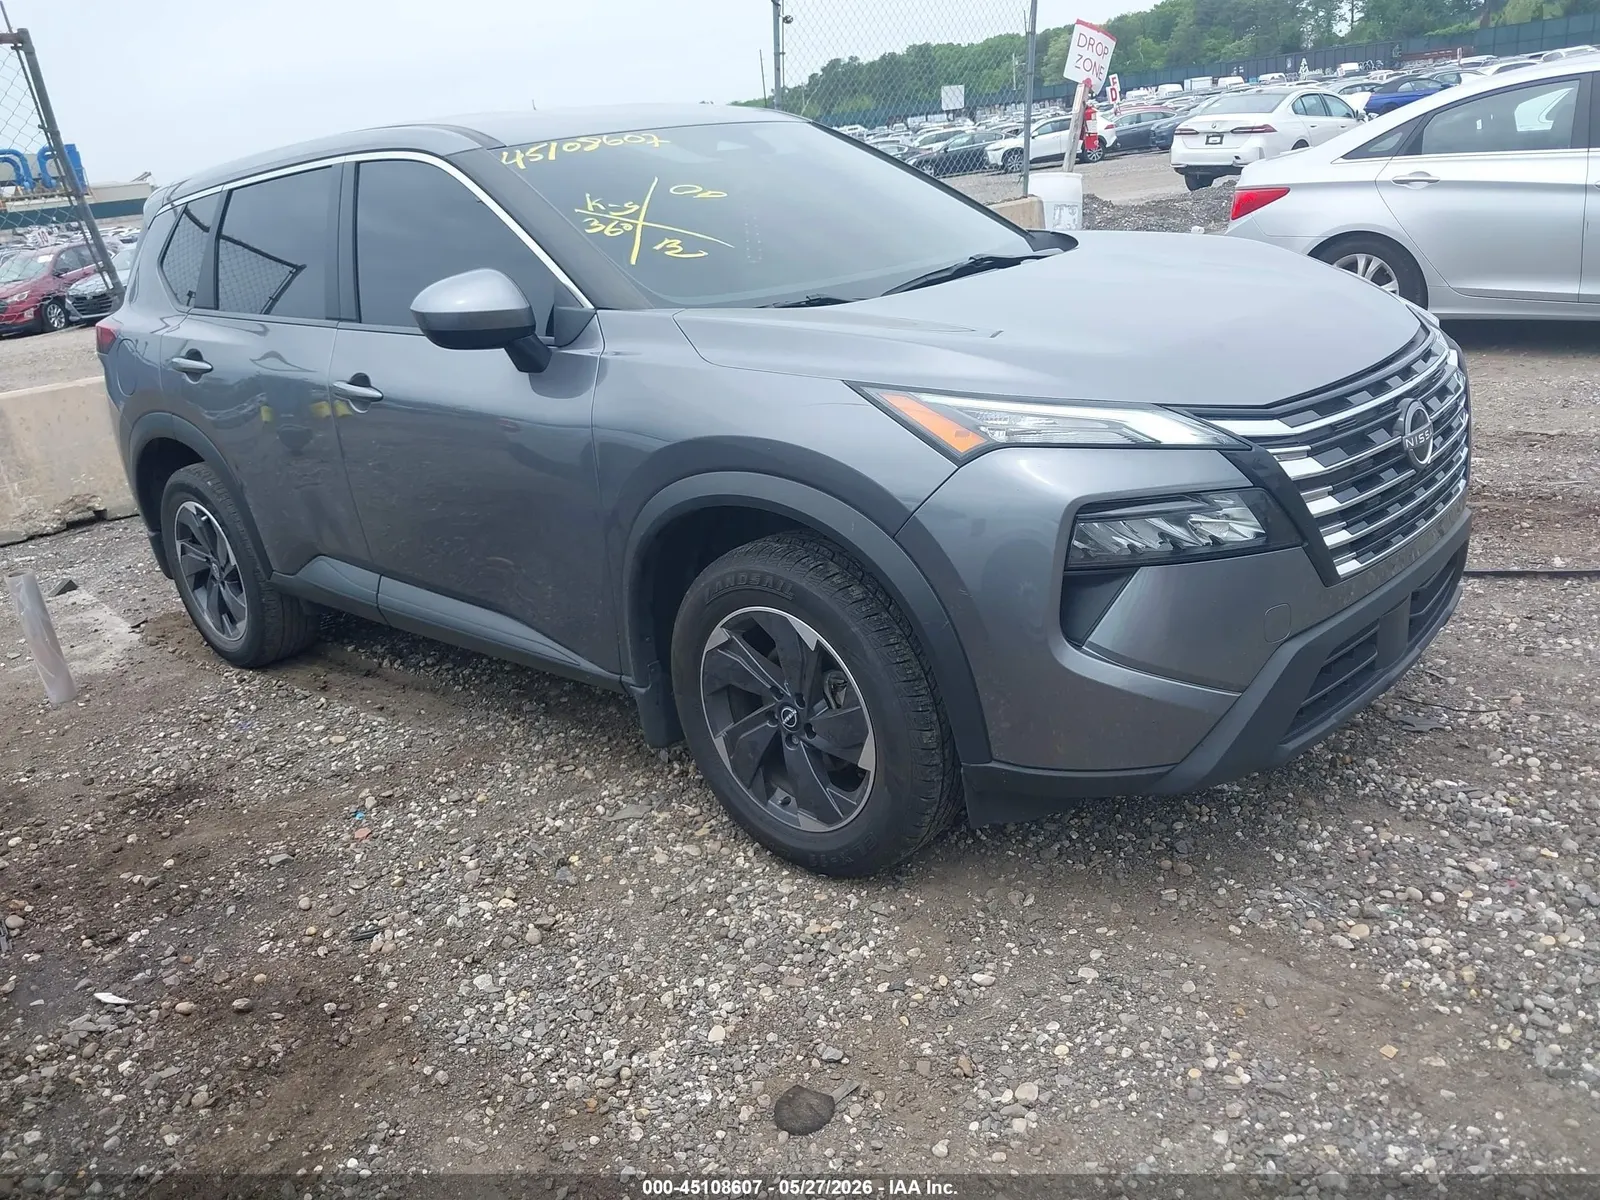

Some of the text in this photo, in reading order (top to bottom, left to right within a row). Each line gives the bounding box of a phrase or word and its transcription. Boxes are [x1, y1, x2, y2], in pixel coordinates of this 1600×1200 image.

[1077, 33, 1109, 60] DROP
[1075, 53, 1105, 81] ZONE
[1110, 87, 1118, 102] D
[501, 133, 670, 169] 45108607
